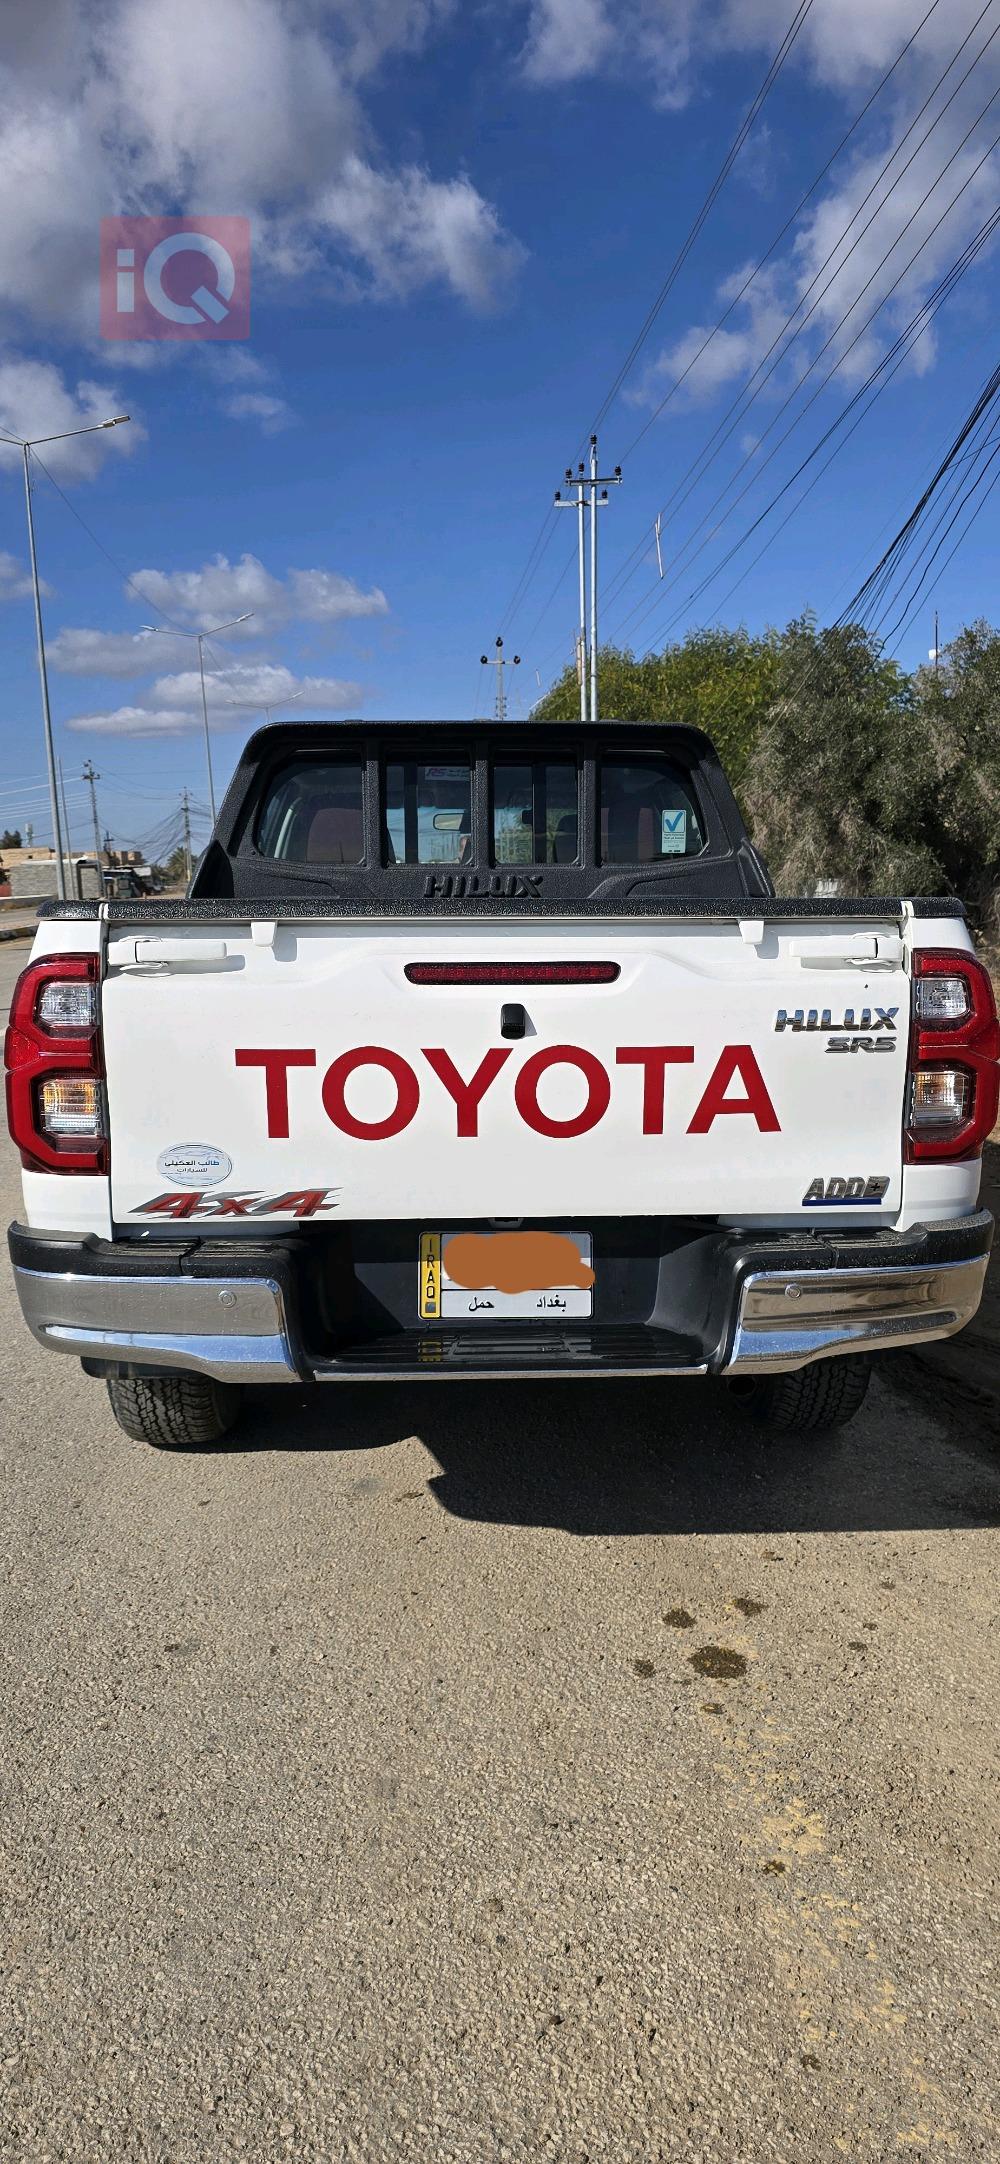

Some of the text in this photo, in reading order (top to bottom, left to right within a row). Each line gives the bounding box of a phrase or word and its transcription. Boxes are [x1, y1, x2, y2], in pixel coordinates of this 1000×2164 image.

[424, 875, 544, 898] HILUX
[775, 1007, 900, 1032] HILUX
[824, 1036, 898, 1053] SR5
[235, 1045, 782, 1141] TOYOTA
[426, 1239, 436, 1299] IRAQ
[468, 1294, 567, 1312] بغداد حمل
